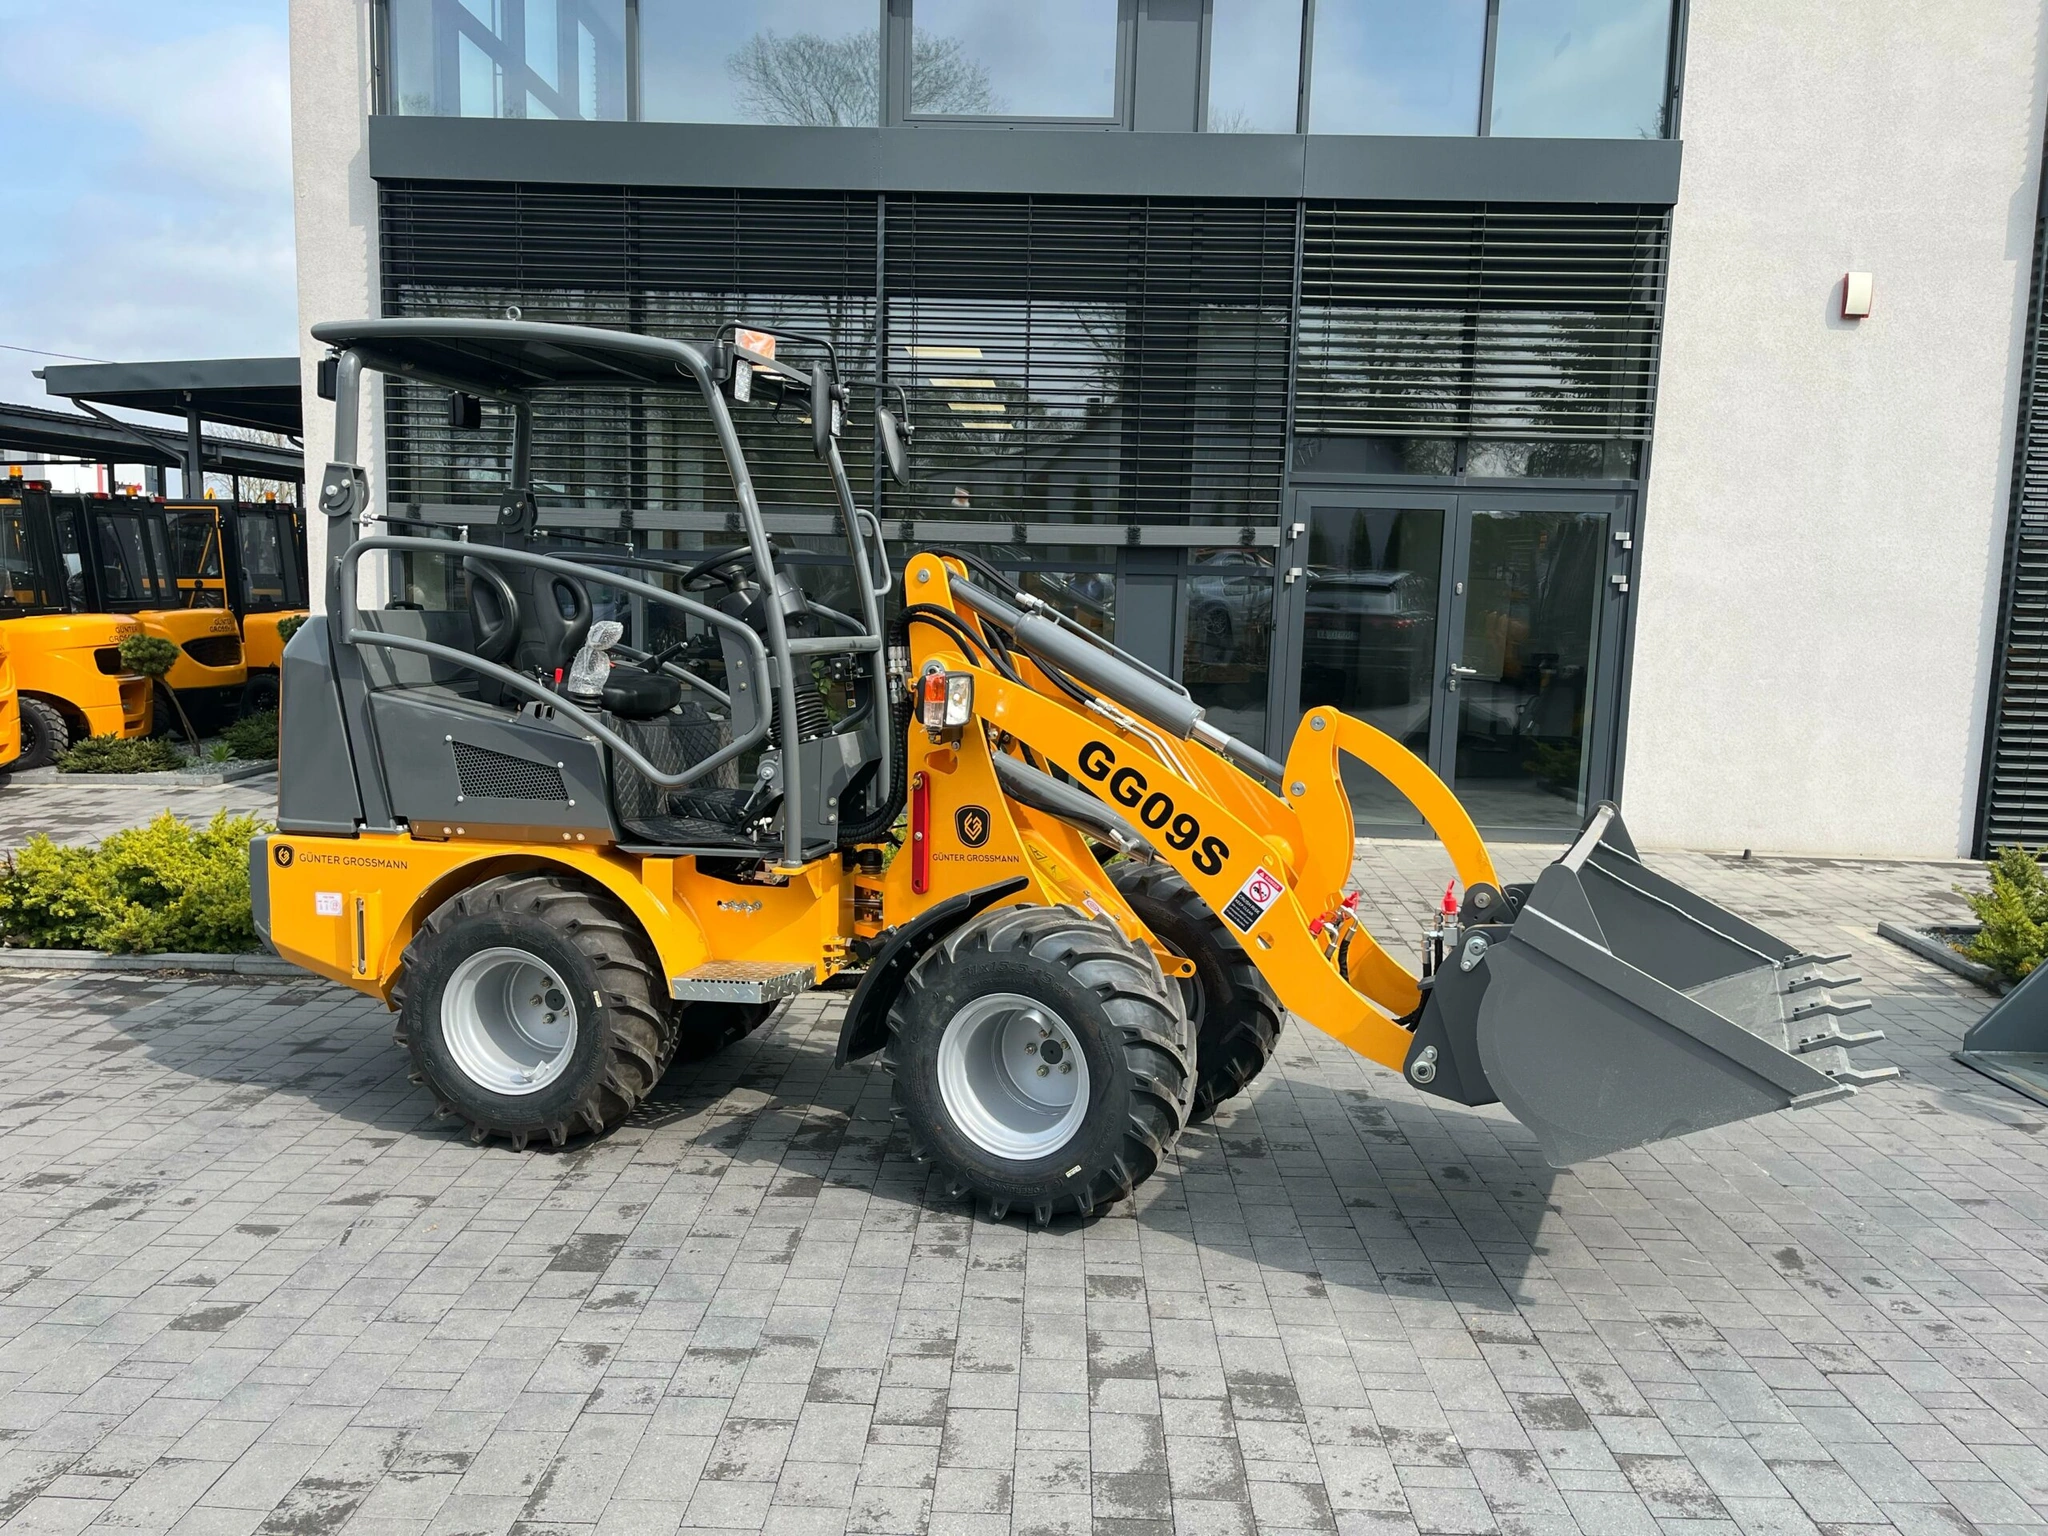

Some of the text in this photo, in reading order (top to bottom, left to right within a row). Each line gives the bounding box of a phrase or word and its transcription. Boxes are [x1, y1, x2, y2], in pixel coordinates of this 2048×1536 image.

[1078, 740, 1230, 876] GG09S
[299, 852, 408, 869] GÜNTER GROSSMANN
[932, 852, 1019, 863] GÜNTER GROSSMANN
